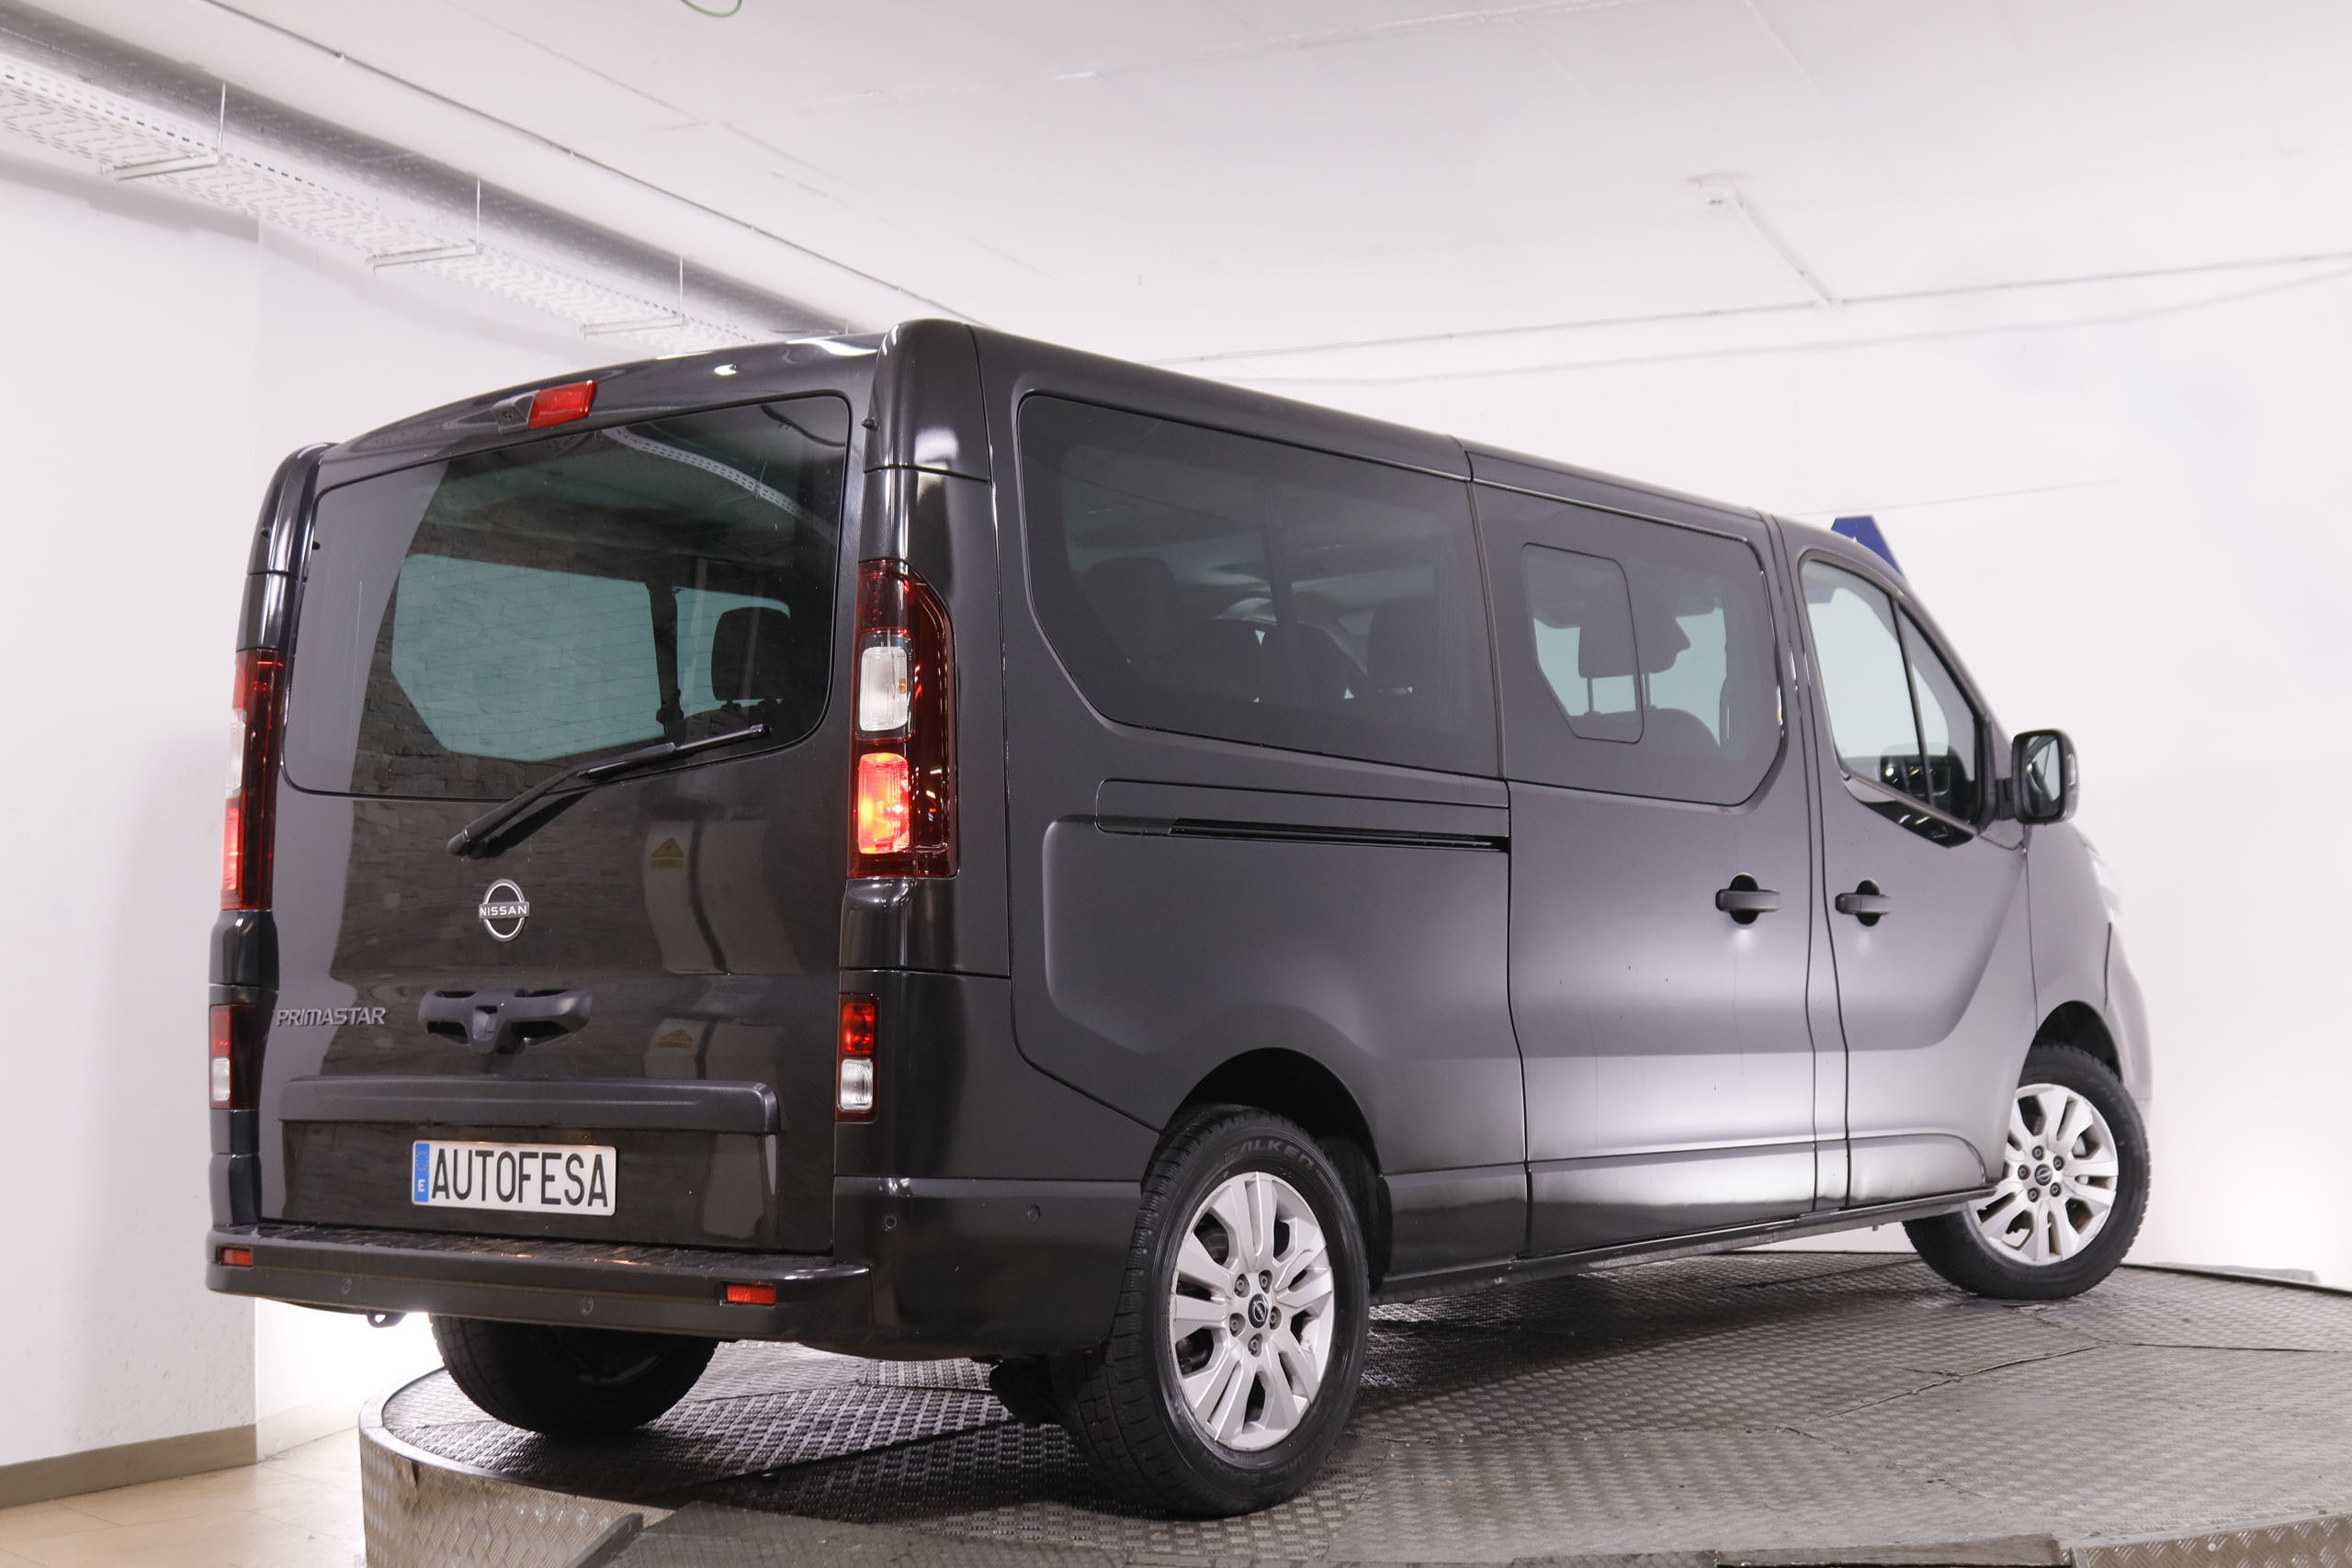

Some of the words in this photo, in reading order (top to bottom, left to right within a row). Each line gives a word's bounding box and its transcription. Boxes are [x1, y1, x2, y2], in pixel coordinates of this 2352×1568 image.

[480, 905, 527, 917] NISSAN
[277, 1007, 387, 1026] PRIMASTAR
[417, 1179, 426, 1192] E
[432, 1148, 608, 1207] AUTOFESA
